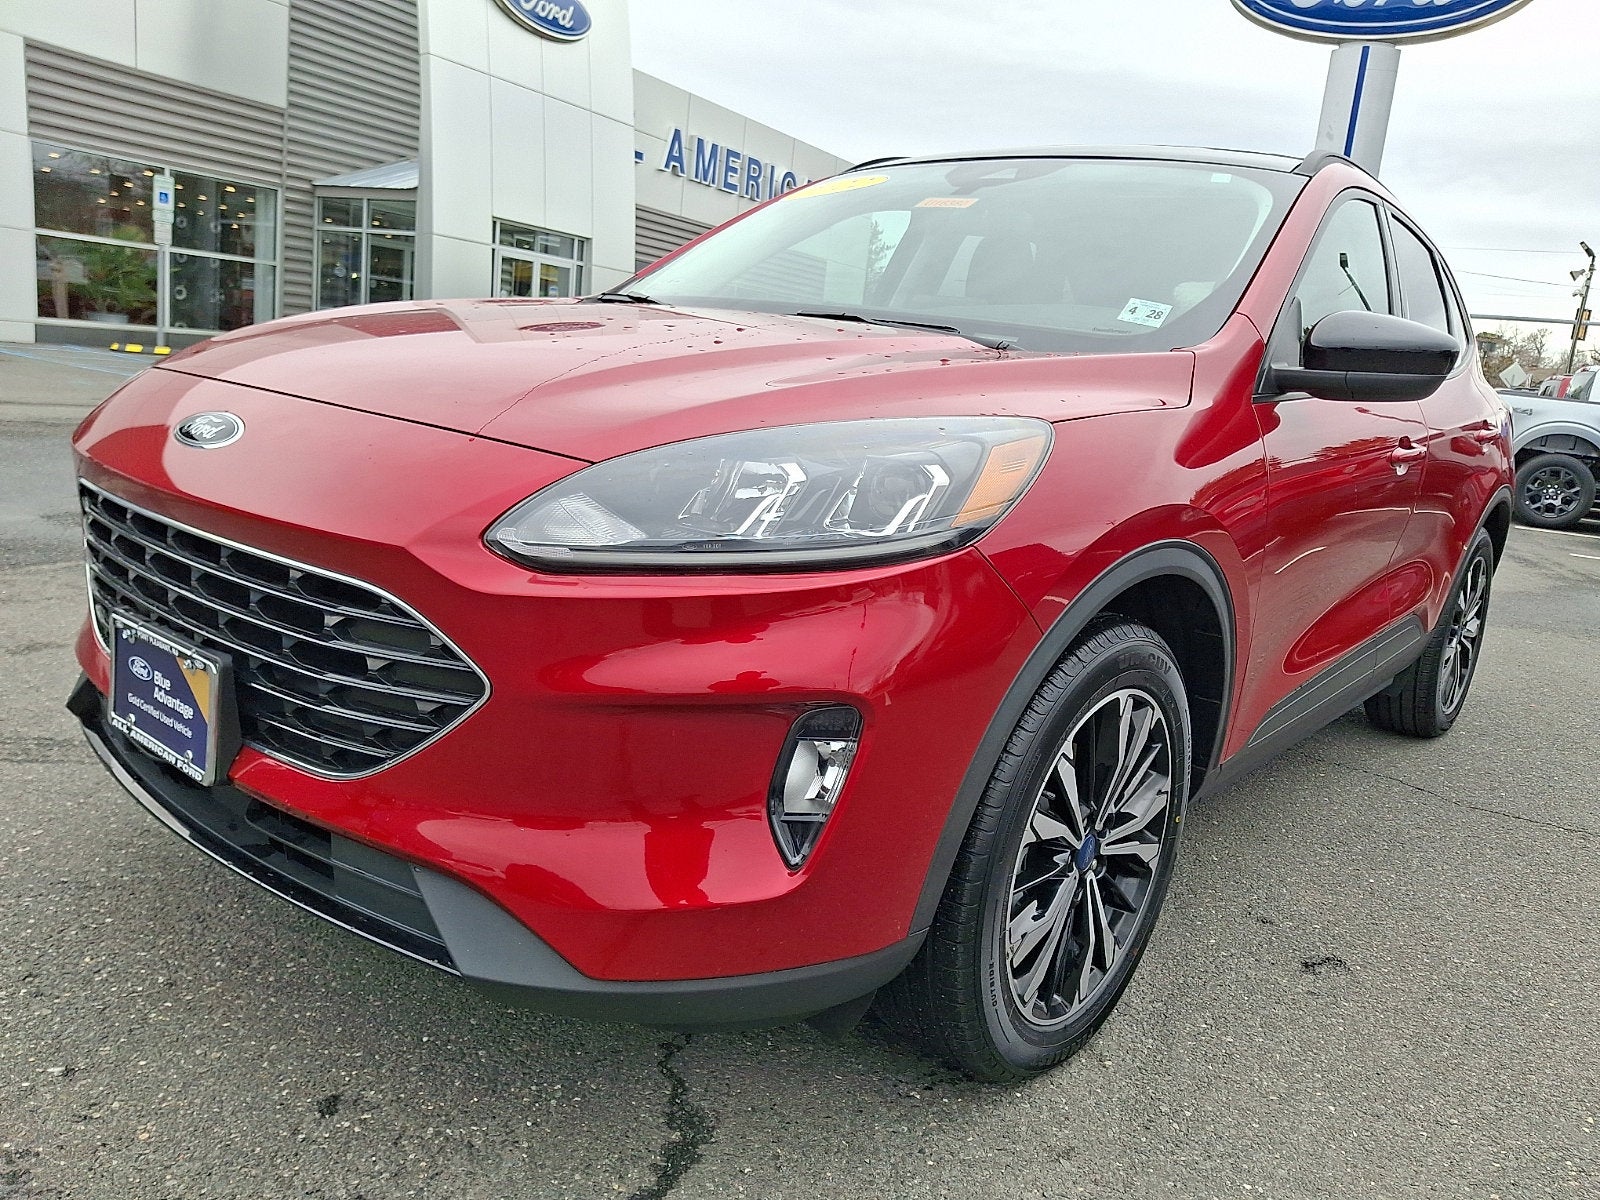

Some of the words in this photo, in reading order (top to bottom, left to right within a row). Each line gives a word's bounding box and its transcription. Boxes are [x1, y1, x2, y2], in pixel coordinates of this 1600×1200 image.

[663, 127, 812, 202] AMERIC
[1128, 306, 1138, 315] 4
[1145, 309, 1164, 320] 28
[185, 415, 226, 439] Ford
[153, 670, 171, 691] Blue
[127, 692, 140, 707] Gold
[139, 699, 160, 719] Certified
[159, 712, 174, 728] Used
[173, 720, 193, 739] Vehicle
[153, 686, 194, 719] Advantage
[111, 719, 130, 734] ALL
[130, 730, 176, 765] AMERICAN
[176, 759, 203, 781] FORD
[989, 961, 998, 1007] OUTSIDE
